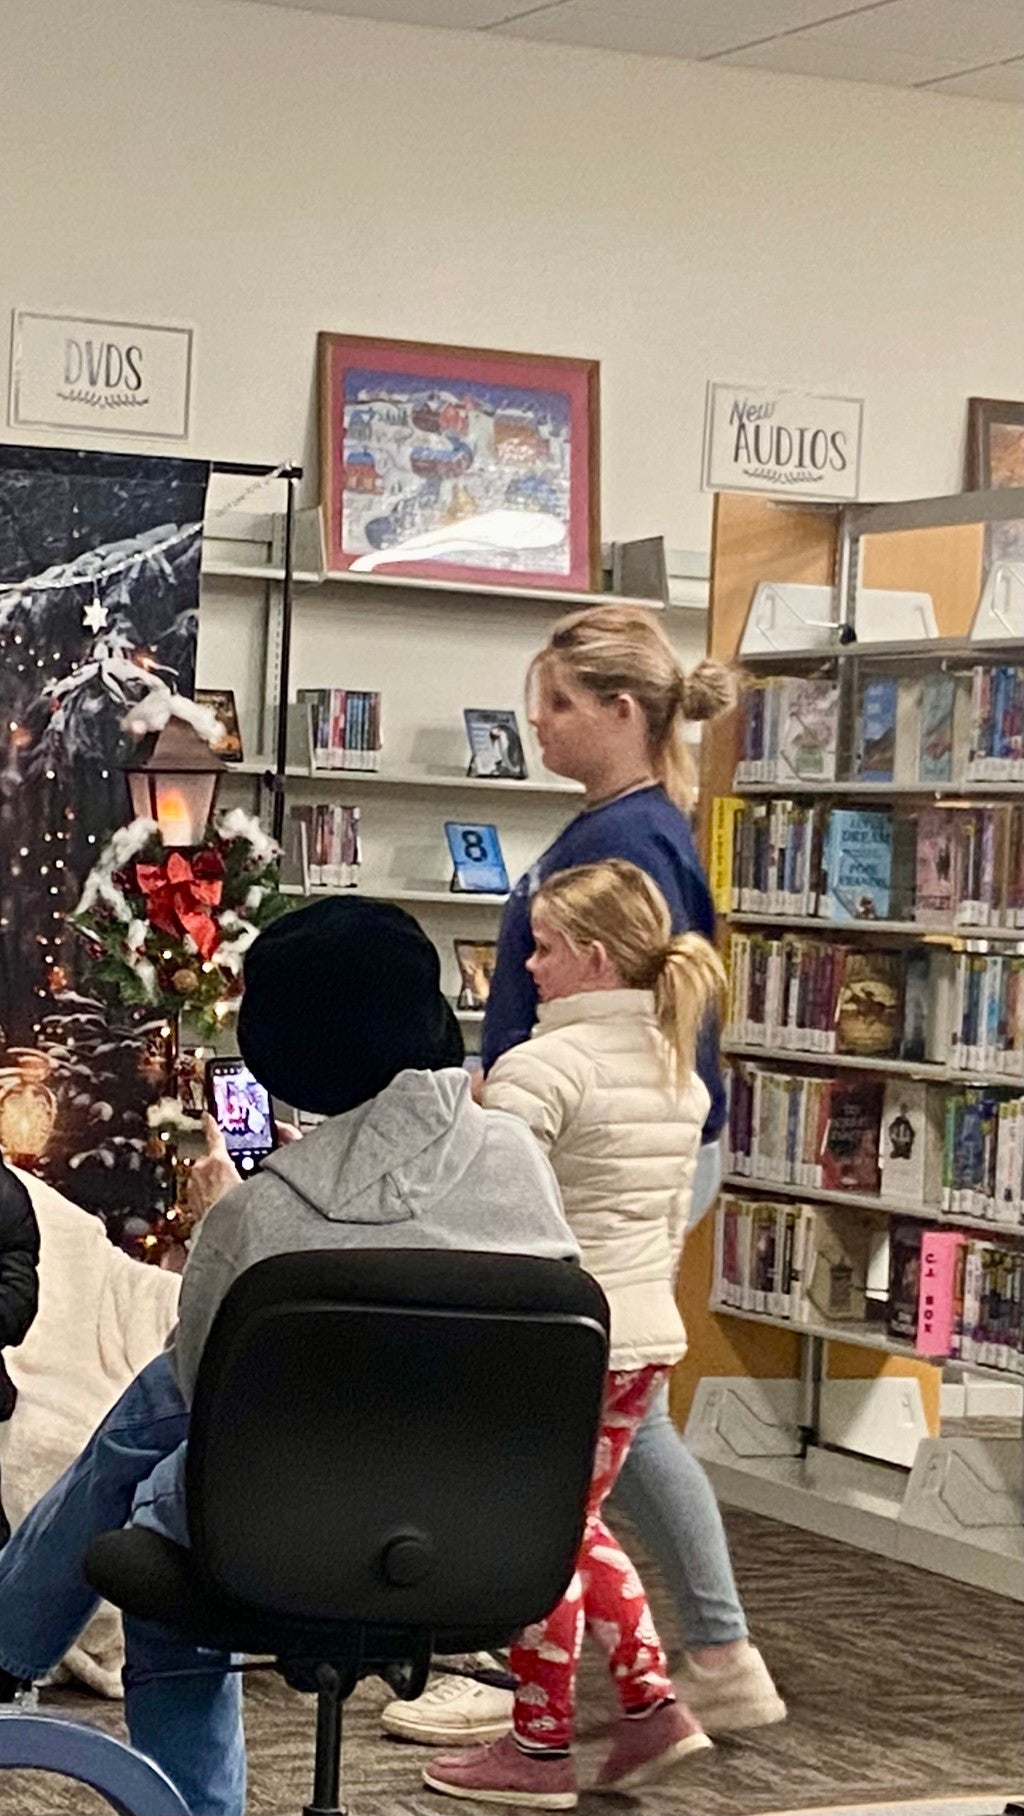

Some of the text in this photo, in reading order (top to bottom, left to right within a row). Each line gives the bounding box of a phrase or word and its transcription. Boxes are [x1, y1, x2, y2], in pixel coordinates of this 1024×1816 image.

[64, 339, 143, 391] DVDS
[729, 397, 777, 425] New
[732, 423, 847, 471] AUDIOS
[461, 830, 488, 862] 8
